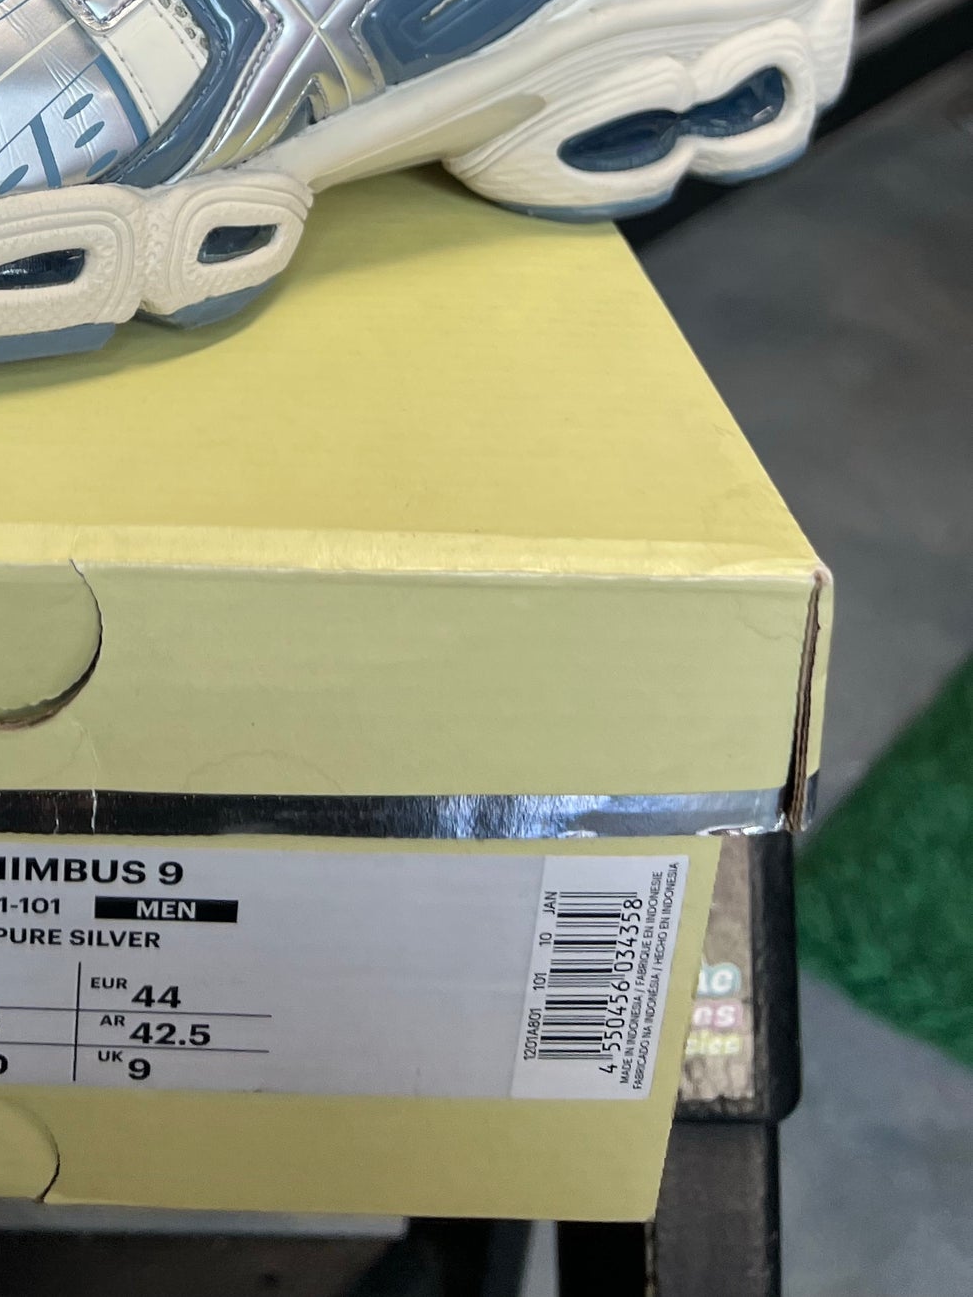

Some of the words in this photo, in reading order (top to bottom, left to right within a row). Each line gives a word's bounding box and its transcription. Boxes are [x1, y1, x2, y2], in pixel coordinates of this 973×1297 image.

[158, 860, 184, 886] 9
[646, 871, 663, 923] INDONESIE
[662, 862, 679, 915] INDONESIA
[136, 900, 196, 921] MEN
[543, 891, 558, 915] JAN
[614, 898, 643, 973] 034358
[643, 926, 654, 939] EN
[659, 917, 670, 930] EN
[69, 929, 161, 949] SILVER
[539, 932, 553, 947] 10
[653, 931, 667, 965] HECHO
[635, 940, 652, 986] FABRIQUE
[90, 976, 128, 990] EUR
[131, 985, 182, 1009] 44
[533, 972, 547, 991] 101
[99, 1014, 126, 1028] AR
[129, 1022, 211, 1047] 42.5
[603, 981, 631, 1052] 550456
[627, 996, 642, 1045] INDONESIA
[524, 1008, 542, 1061] 1201A801
[642, 1025, 652, 1039] NA
[97, 1050, 123, 1063] UK
[127, 1058, 151, 1081] 9
[625, 1047, 634, 1057] IN
[633, 1041, 649, 1090] FABRICADO
[599, 1063, 618, 1074] 4
[620, 1058, 633, 1084] MADE
